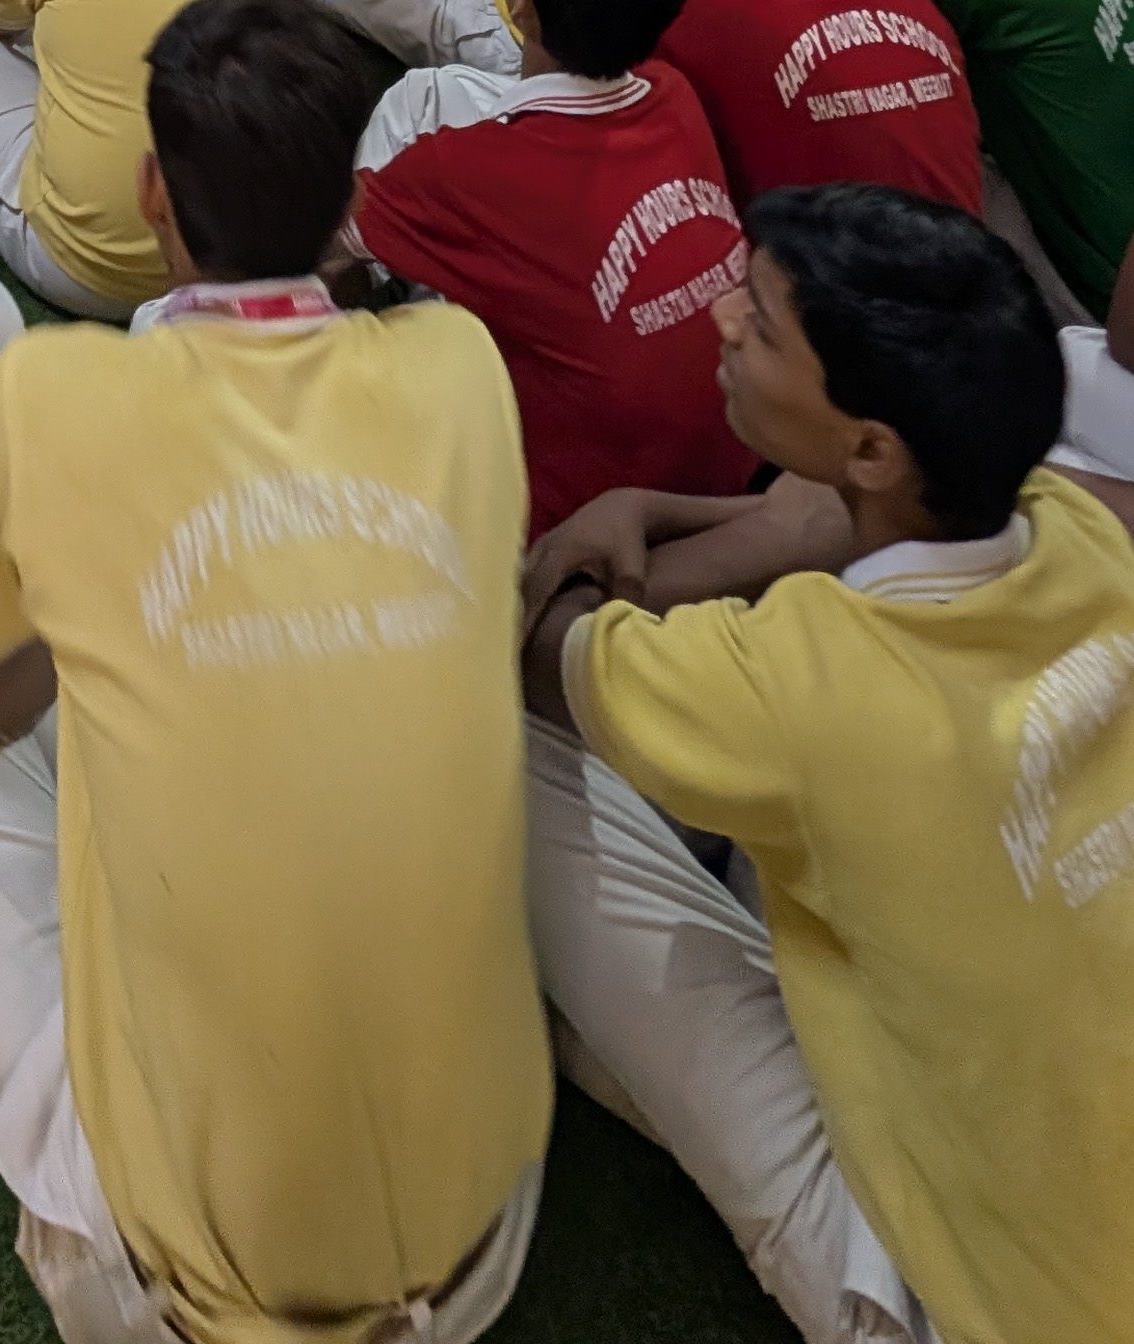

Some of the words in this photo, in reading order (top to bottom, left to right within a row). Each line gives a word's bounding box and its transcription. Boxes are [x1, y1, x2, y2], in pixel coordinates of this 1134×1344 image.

[774, 24, 828, 109] HAPPY
[820, 9, 884, 54] HOURS
[876, 9, 961, 76] SCHOOL
[807, 88, 869, 122] SHASTRI
[591, 213, 647, 324] HAPPY
[632, 179, 697, 245] HOURS
[629, 285, 696, 337] SHASTRI
